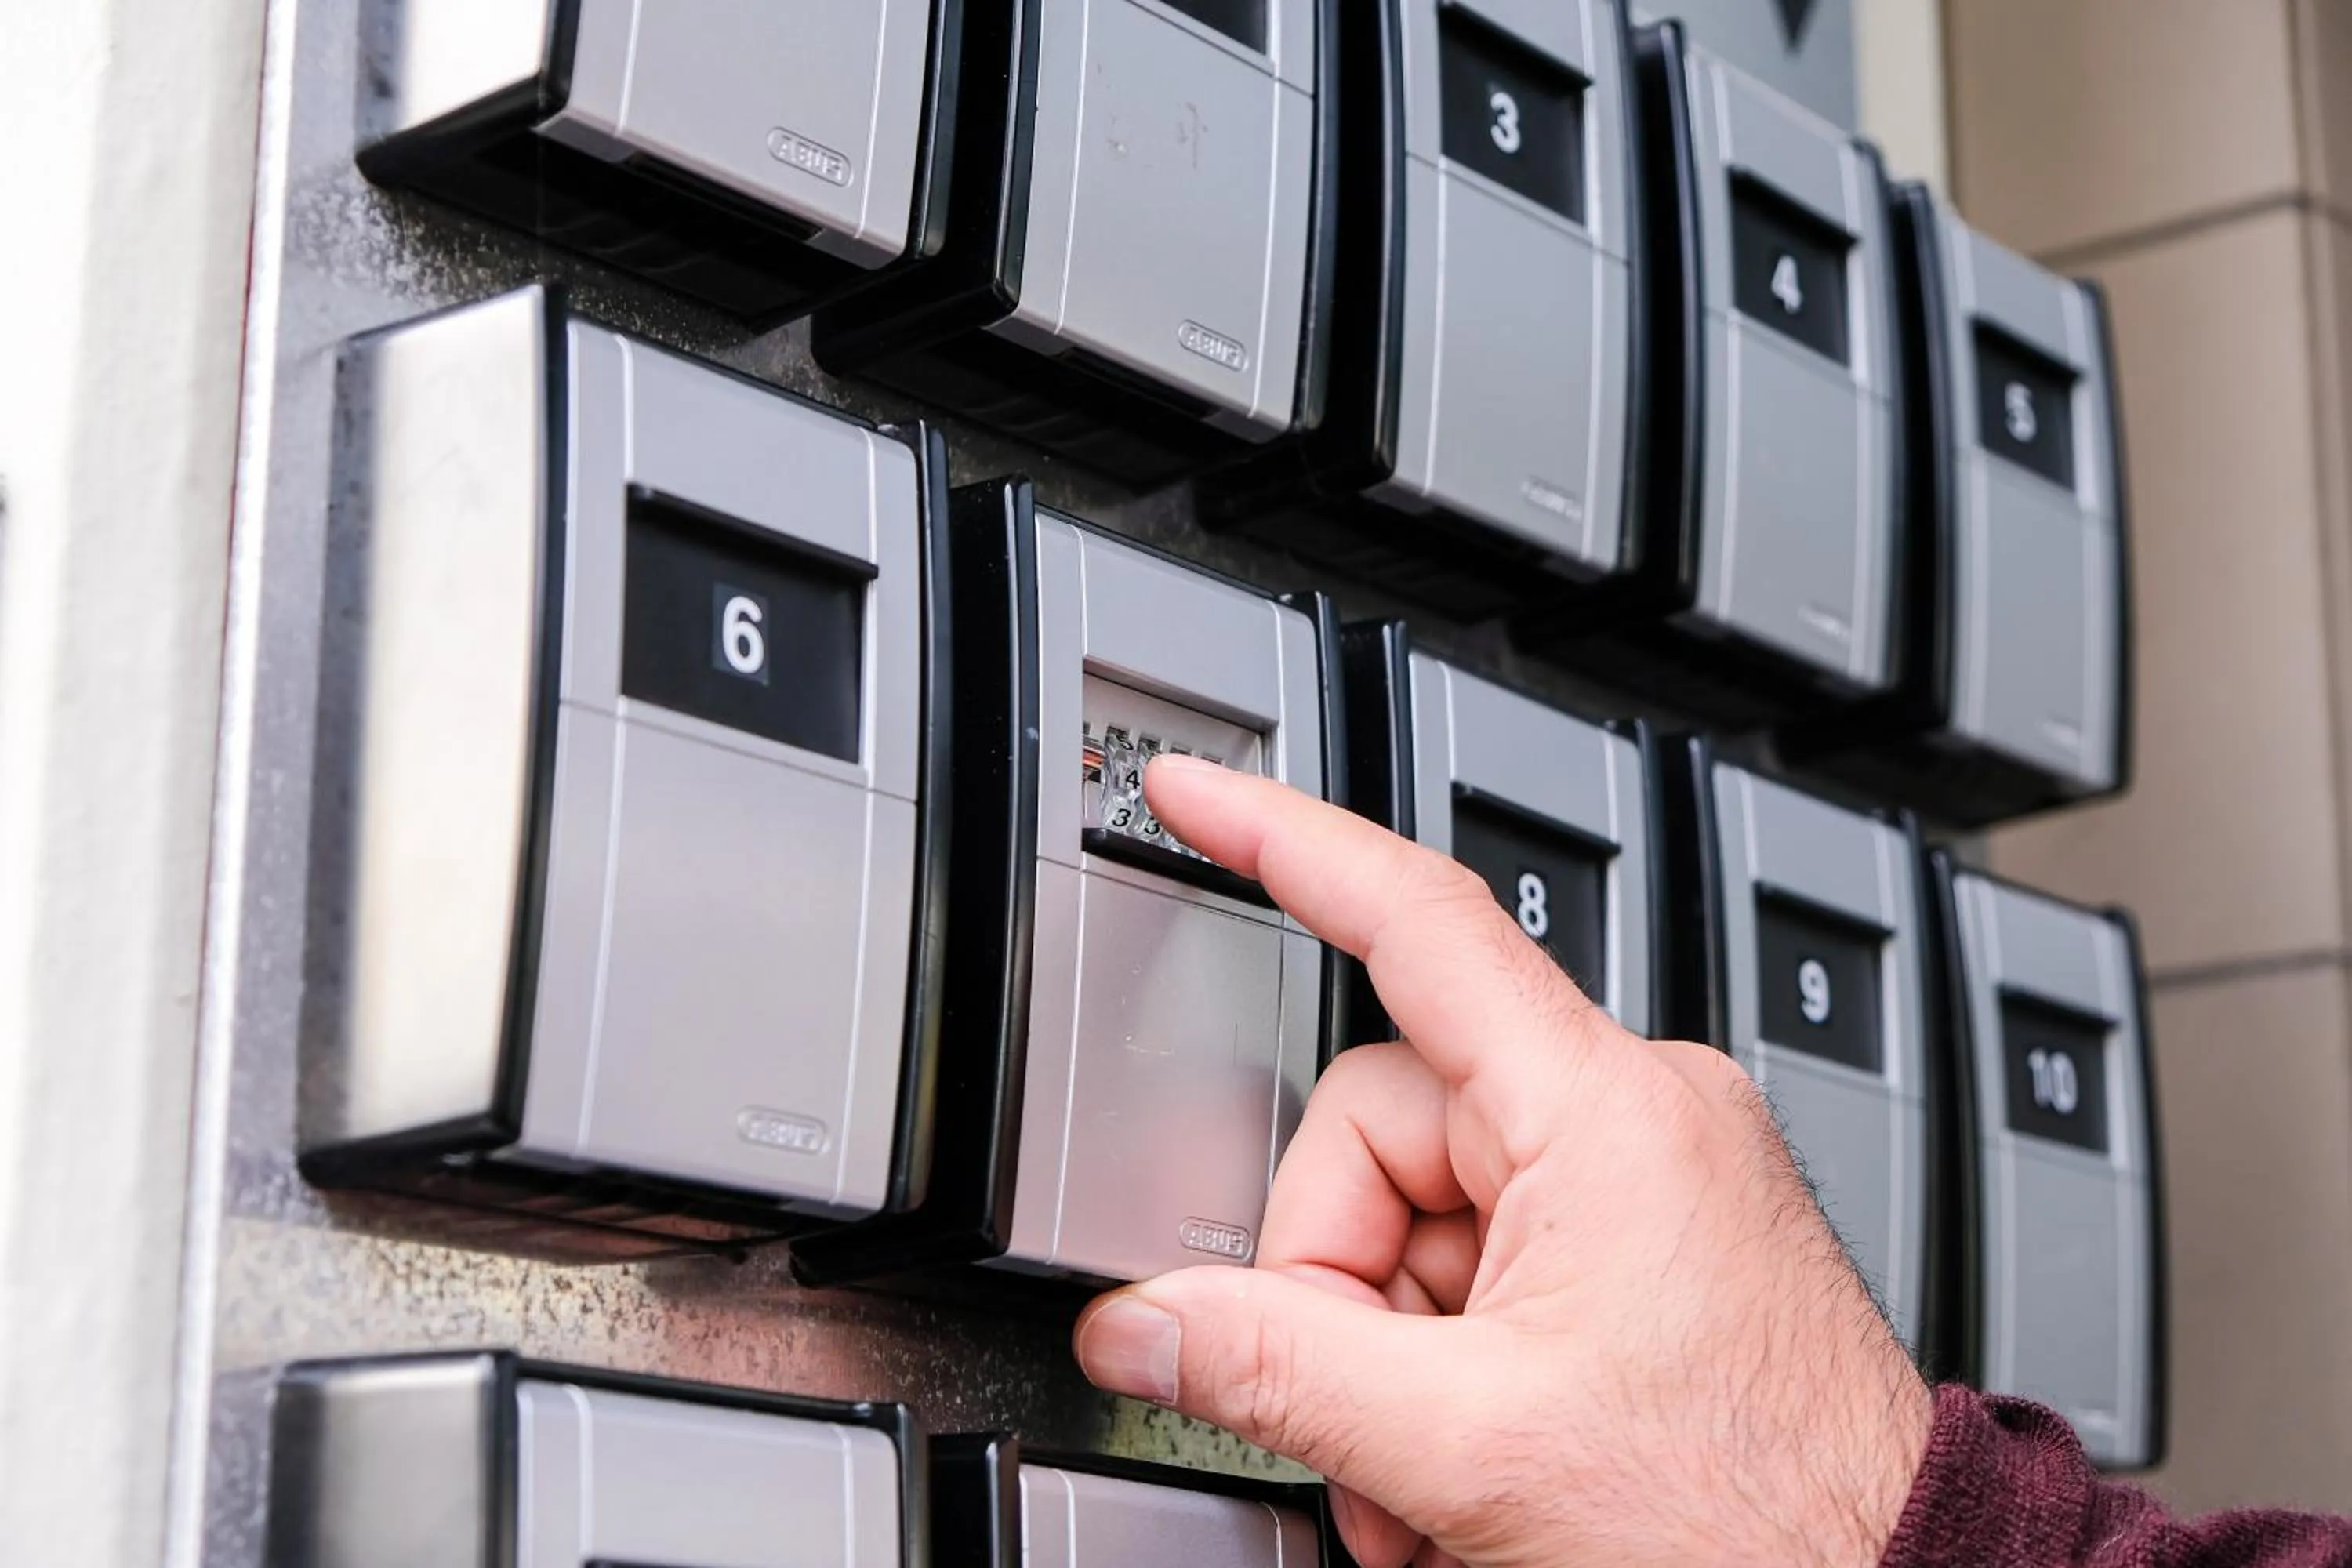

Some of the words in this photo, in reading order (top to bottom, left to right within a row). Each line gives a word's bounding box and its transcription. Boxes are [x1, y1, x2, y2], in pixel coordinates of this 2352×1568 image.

[1490, 92, 1520, 154] 3
[775, 134, 844, 181] ABUS
[1771, 255, 1802, 314] 4
[1185, 325, 1240, 367] ABUS
[2005, 381, 2037, 443] 5
[722, 596, 764, 673] 6
[1125, 769, 1141, 789] 4
[1112, 808, 1131, 827] 3
[1518, 873, 1548, 938] 8
[1799, 960, 1829, 1023] 9
[2027, 1047, 2078, 1114] 10
[1187, 1223, 1245, 1254] ABUS
